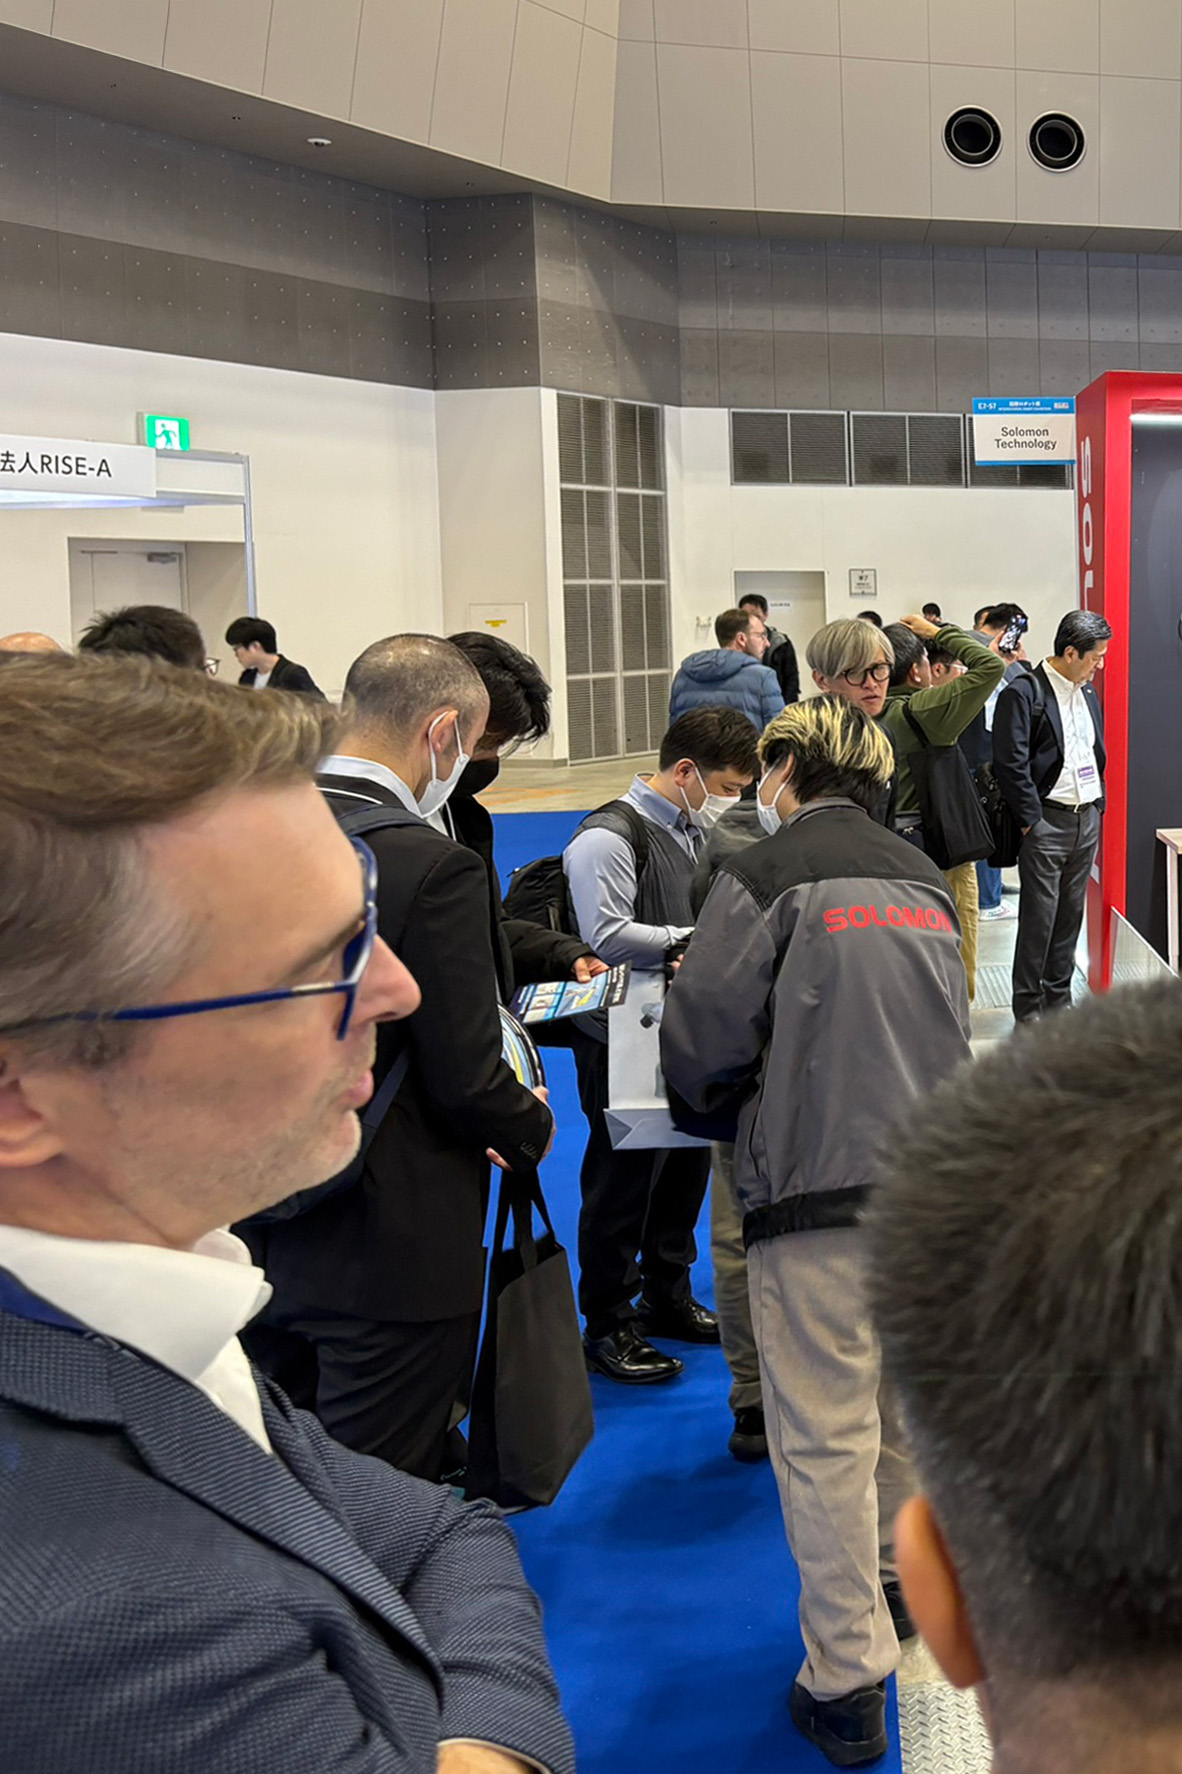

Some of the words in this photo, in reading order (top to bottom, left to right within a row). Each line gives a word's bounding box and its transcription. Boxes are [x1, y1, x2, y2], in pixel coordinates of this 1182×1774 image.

[1001, 426, 1049, 437] Solomon
[994, 438, 1057, 451] Technology
[0, 450, 112, 478] 法人RISE-A
[823, 904, 953, 933] SOLOMON
